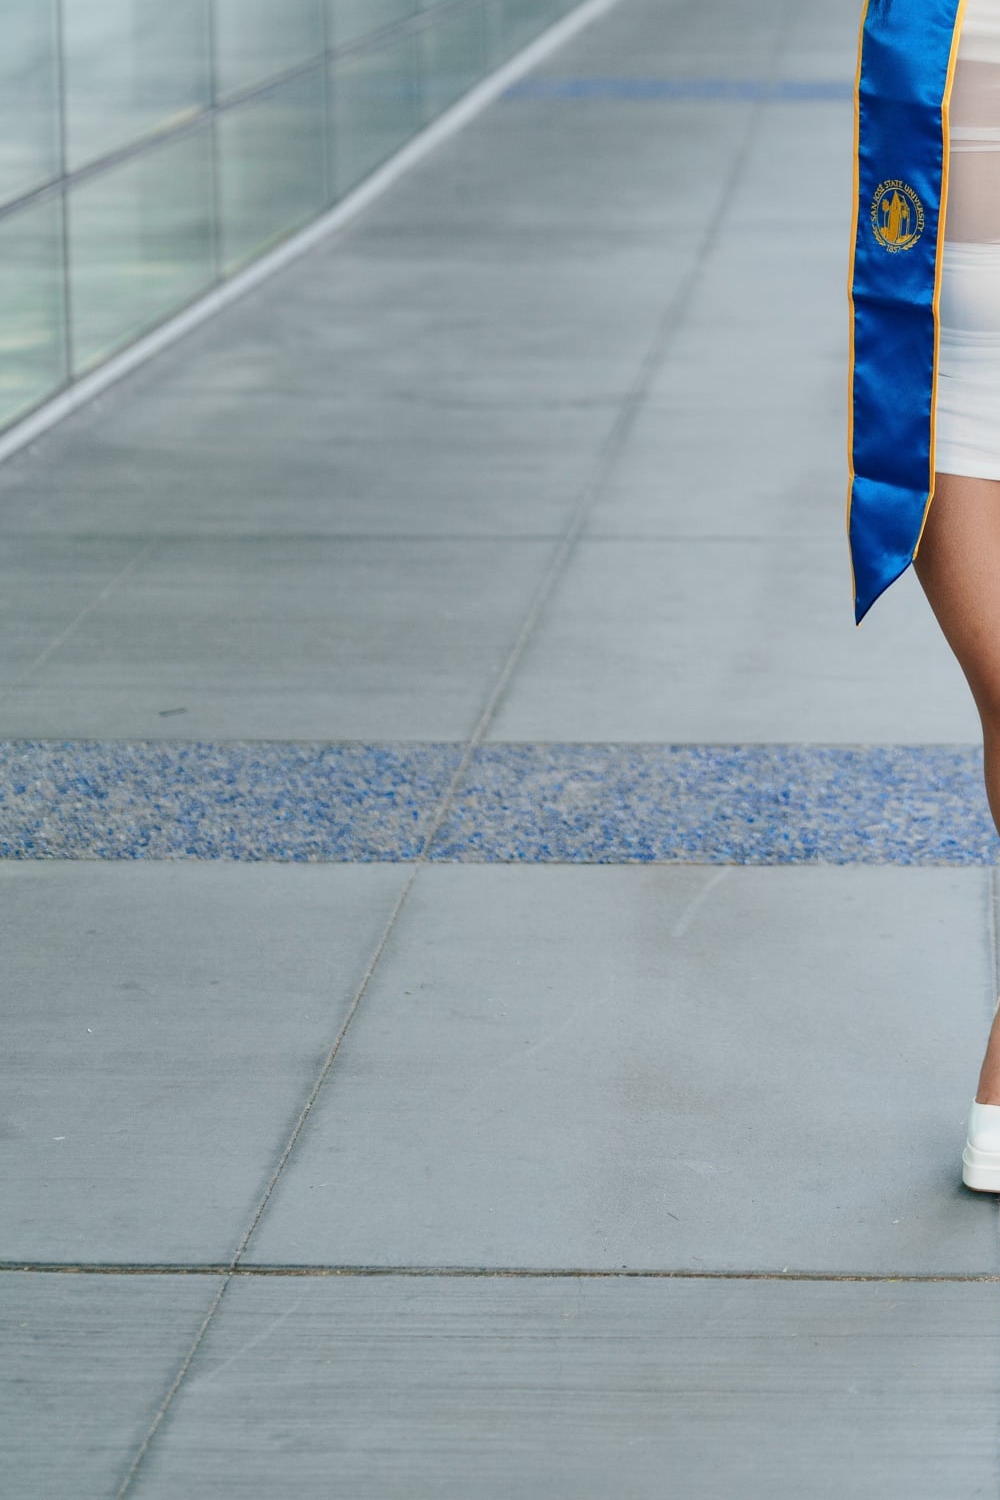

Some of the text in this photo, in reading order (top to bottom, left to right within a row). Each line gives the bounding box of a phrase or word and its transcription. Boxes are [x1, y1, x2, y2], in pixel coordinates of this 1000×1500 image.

[870, 202, 878, 222] SAN
[884, 180, 903, 189] STATE
[904, 184, 925, 232] UNIVERSITY
[886, 244, 901, 254] 1857
